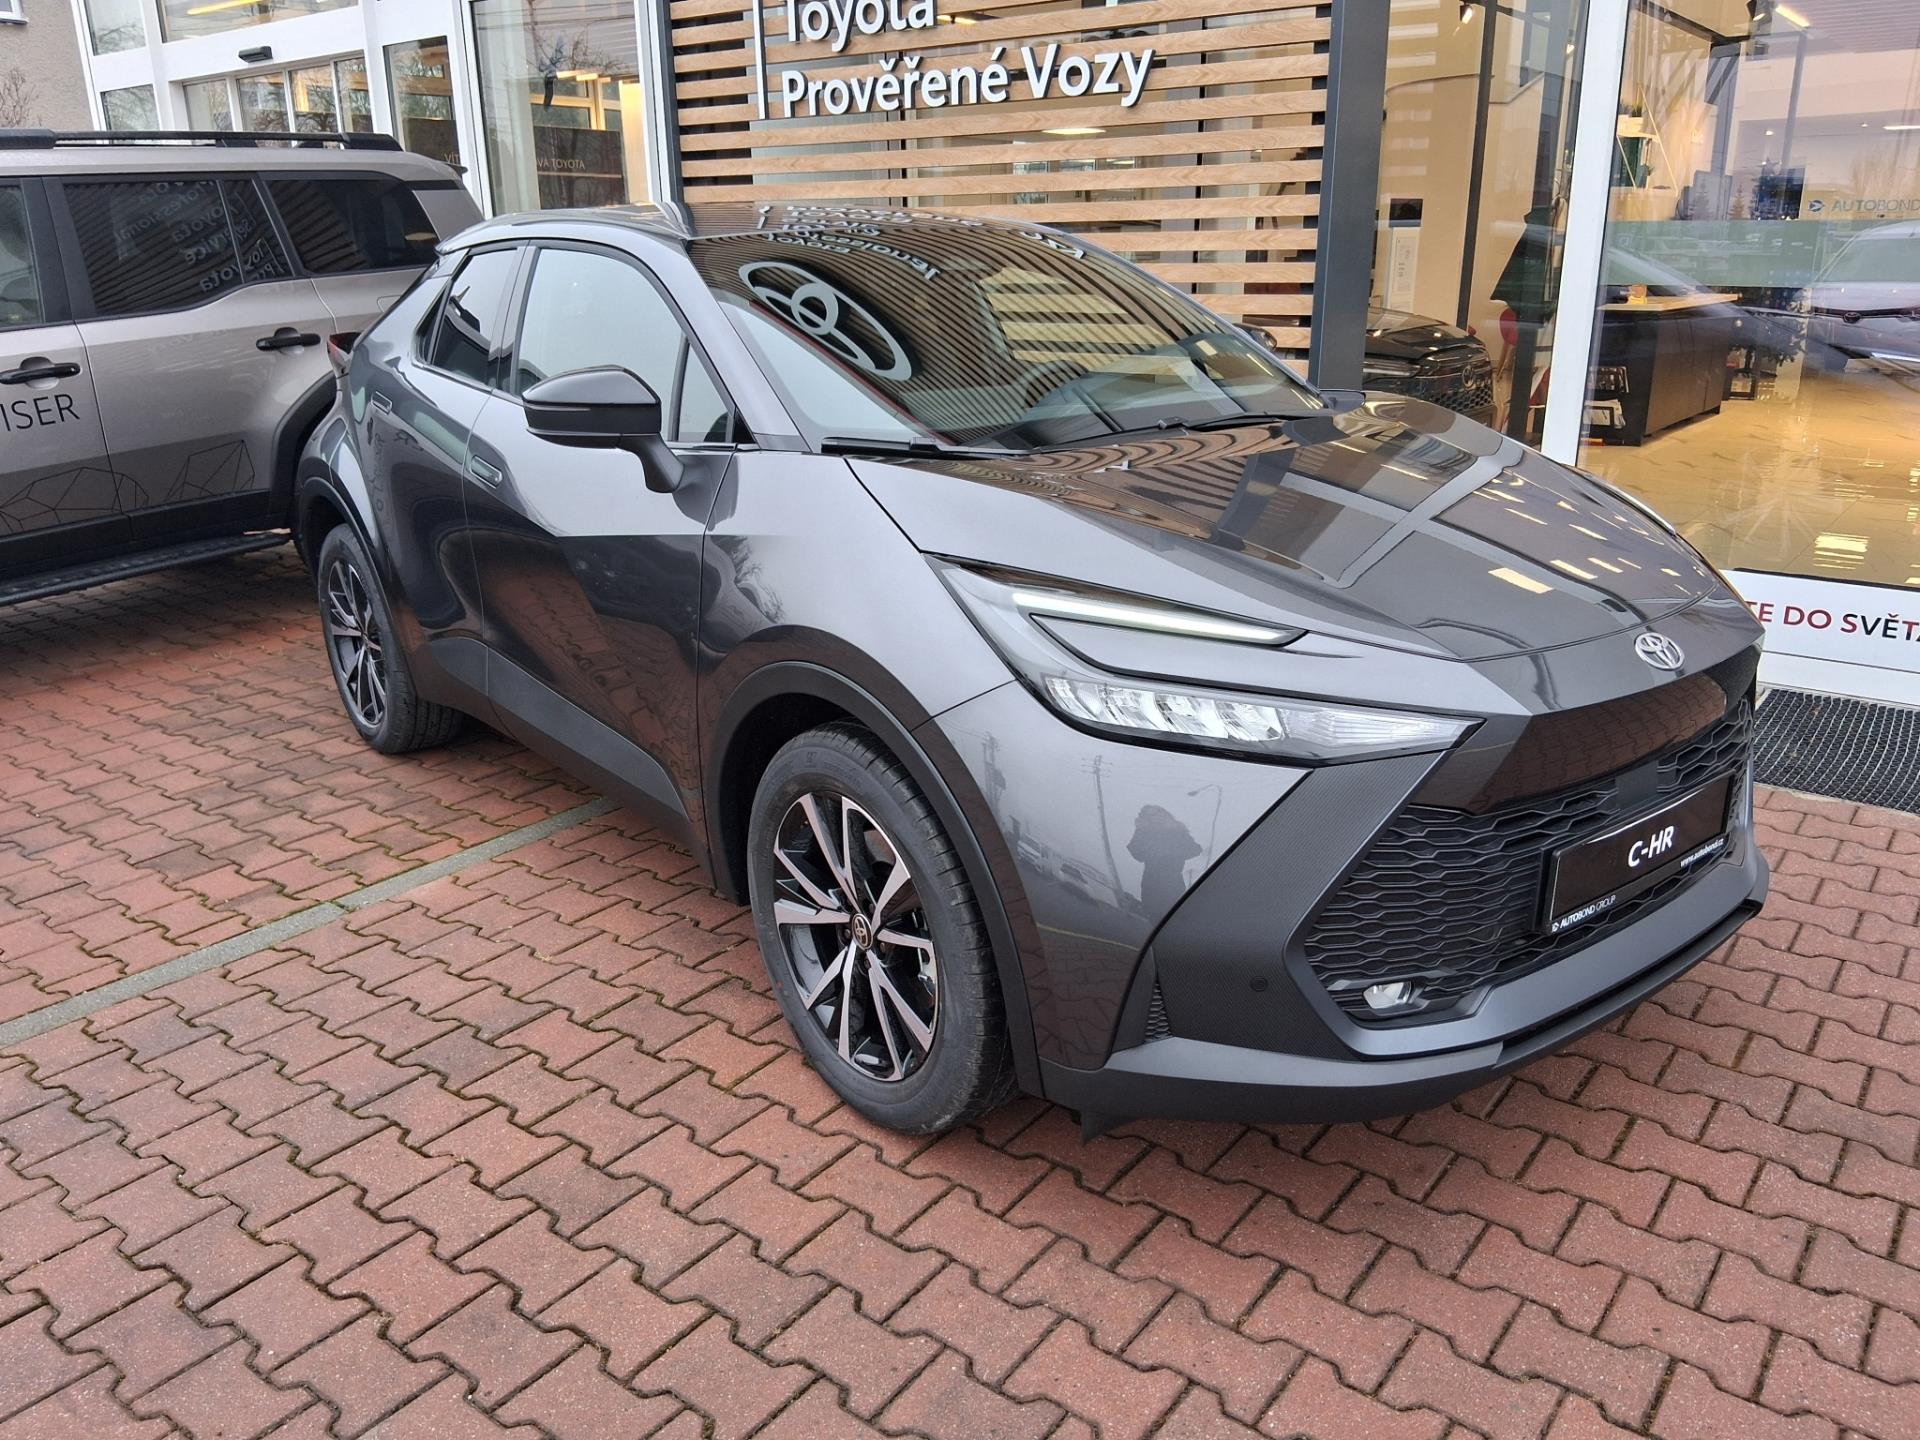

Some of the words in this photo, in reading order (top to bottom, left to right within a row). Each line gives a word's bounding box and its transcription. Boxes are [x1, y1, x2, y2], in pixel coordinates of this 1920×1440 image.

[787, 0, 936, 52] Toyota
[782, 46, 1010, 118] Prověřené
[1021, 43, 1158, 107] Vozy
[1783, 605, 1832, 630] DO
[1840, 612, 1920, 642] SVĚT
[1627, 825, 1675, 867] C-HR
[1559, 904, 1596, 929] AUTOBOND
